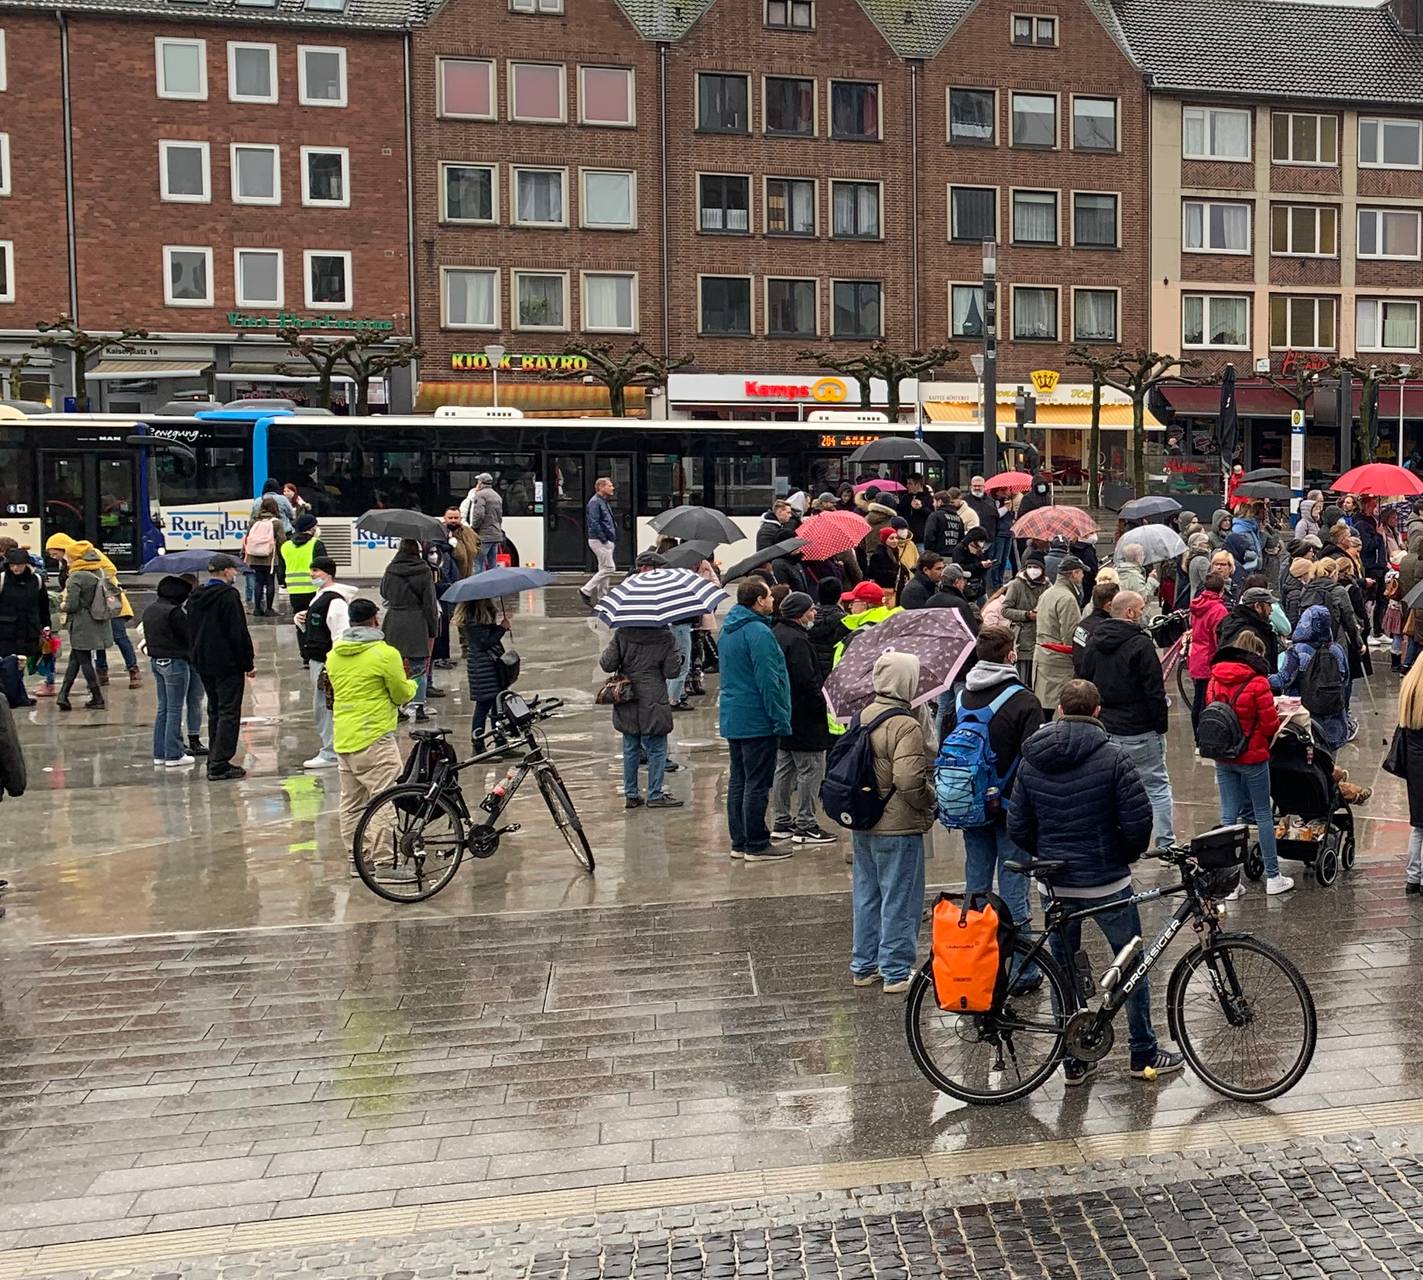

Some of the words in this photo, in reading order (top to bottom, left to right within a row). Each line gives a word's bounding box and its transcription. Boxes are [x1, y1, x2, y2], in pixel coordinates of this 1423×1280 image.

[452, 352, 512, 371] KIOK
[521, 353, 588, 373] BAYRO
[1122, 919, 1182, 994] DROSSIGER
